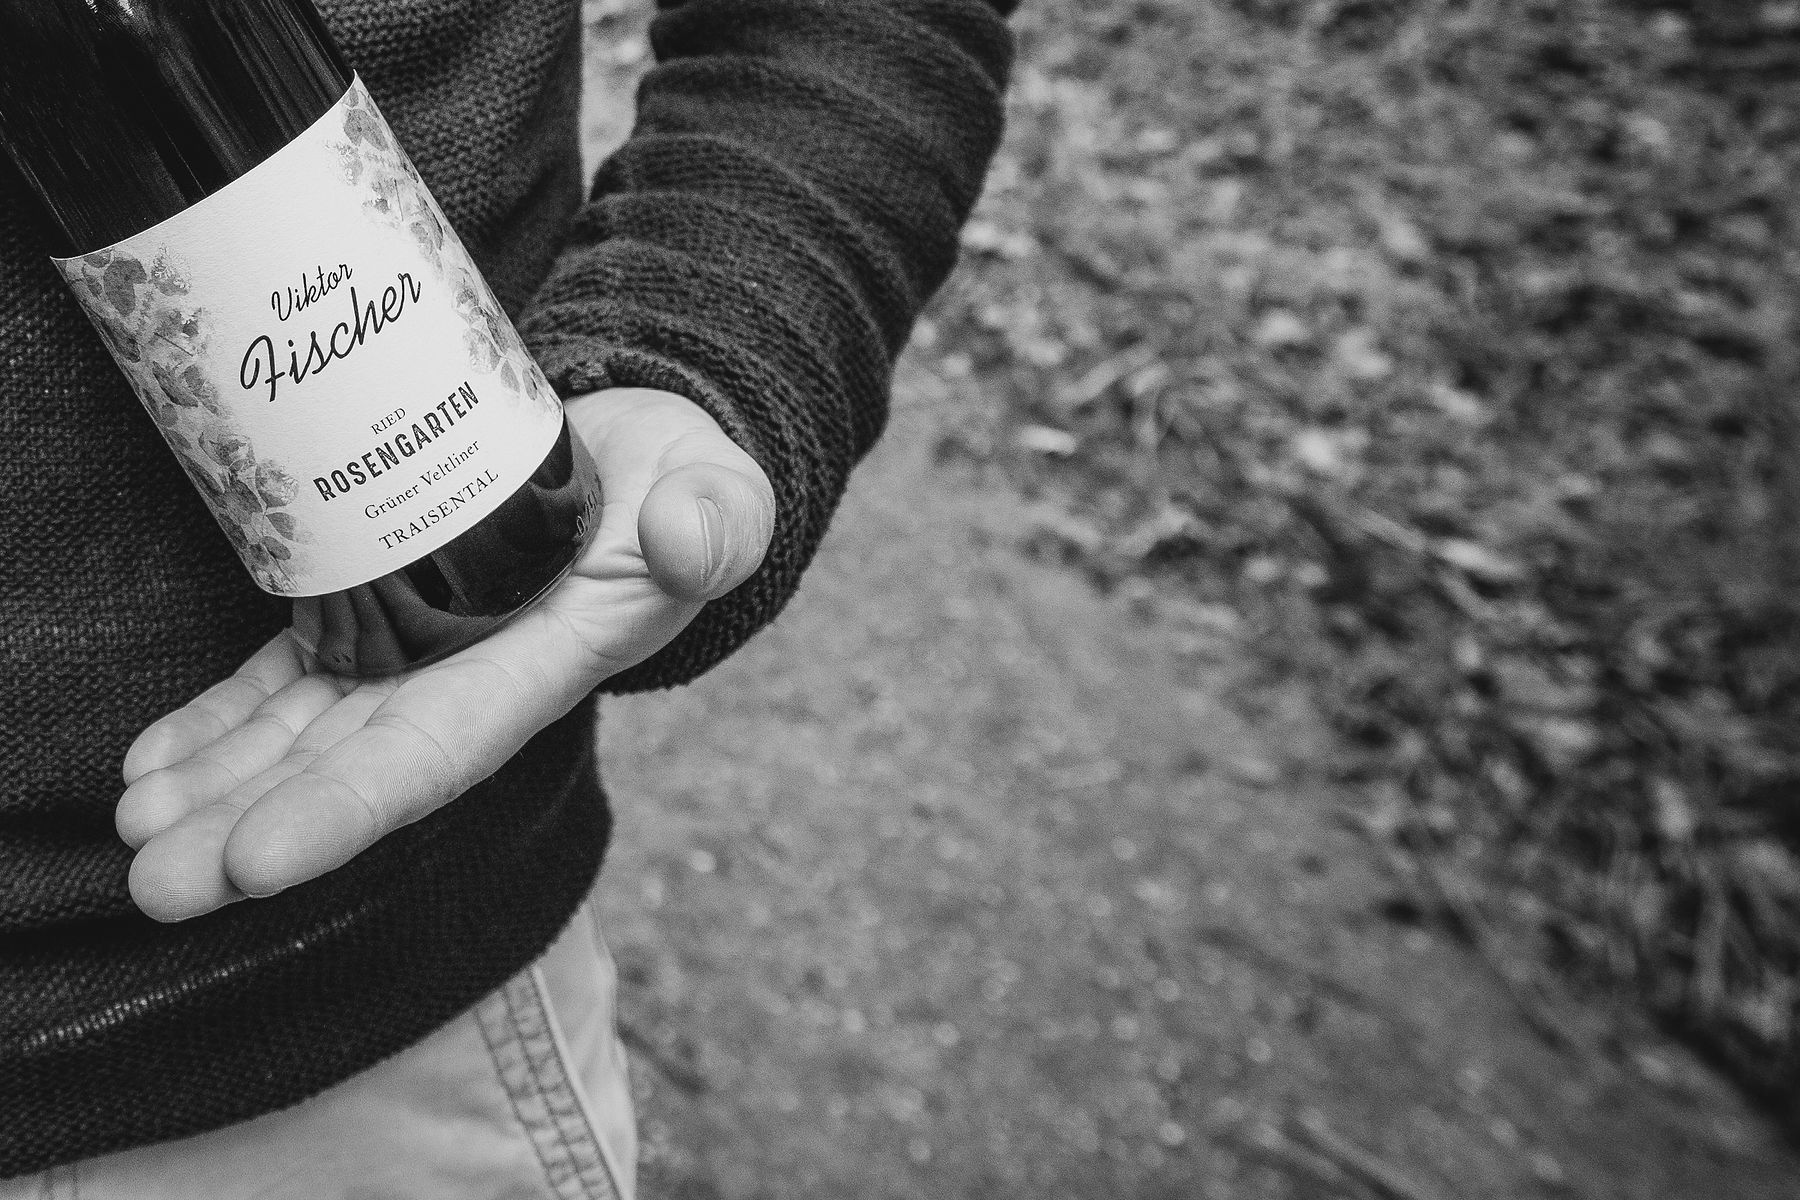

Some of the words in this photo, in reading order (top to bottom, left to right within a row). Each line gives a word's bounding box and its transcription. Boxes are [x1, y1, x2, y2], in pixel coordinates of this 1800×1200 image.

[271, 263, 353, 322] Viktor
[239, 272, 421, 403] Fischer
[312, 380, 480, 502] ROSENGARTEN
[370, 406, 407, 435] RIED
[364, 483, 420, 519] Grüner
[419, 439, 481, 487] Veltliner
[378, 468, 500, 550] TRAISENTAL
